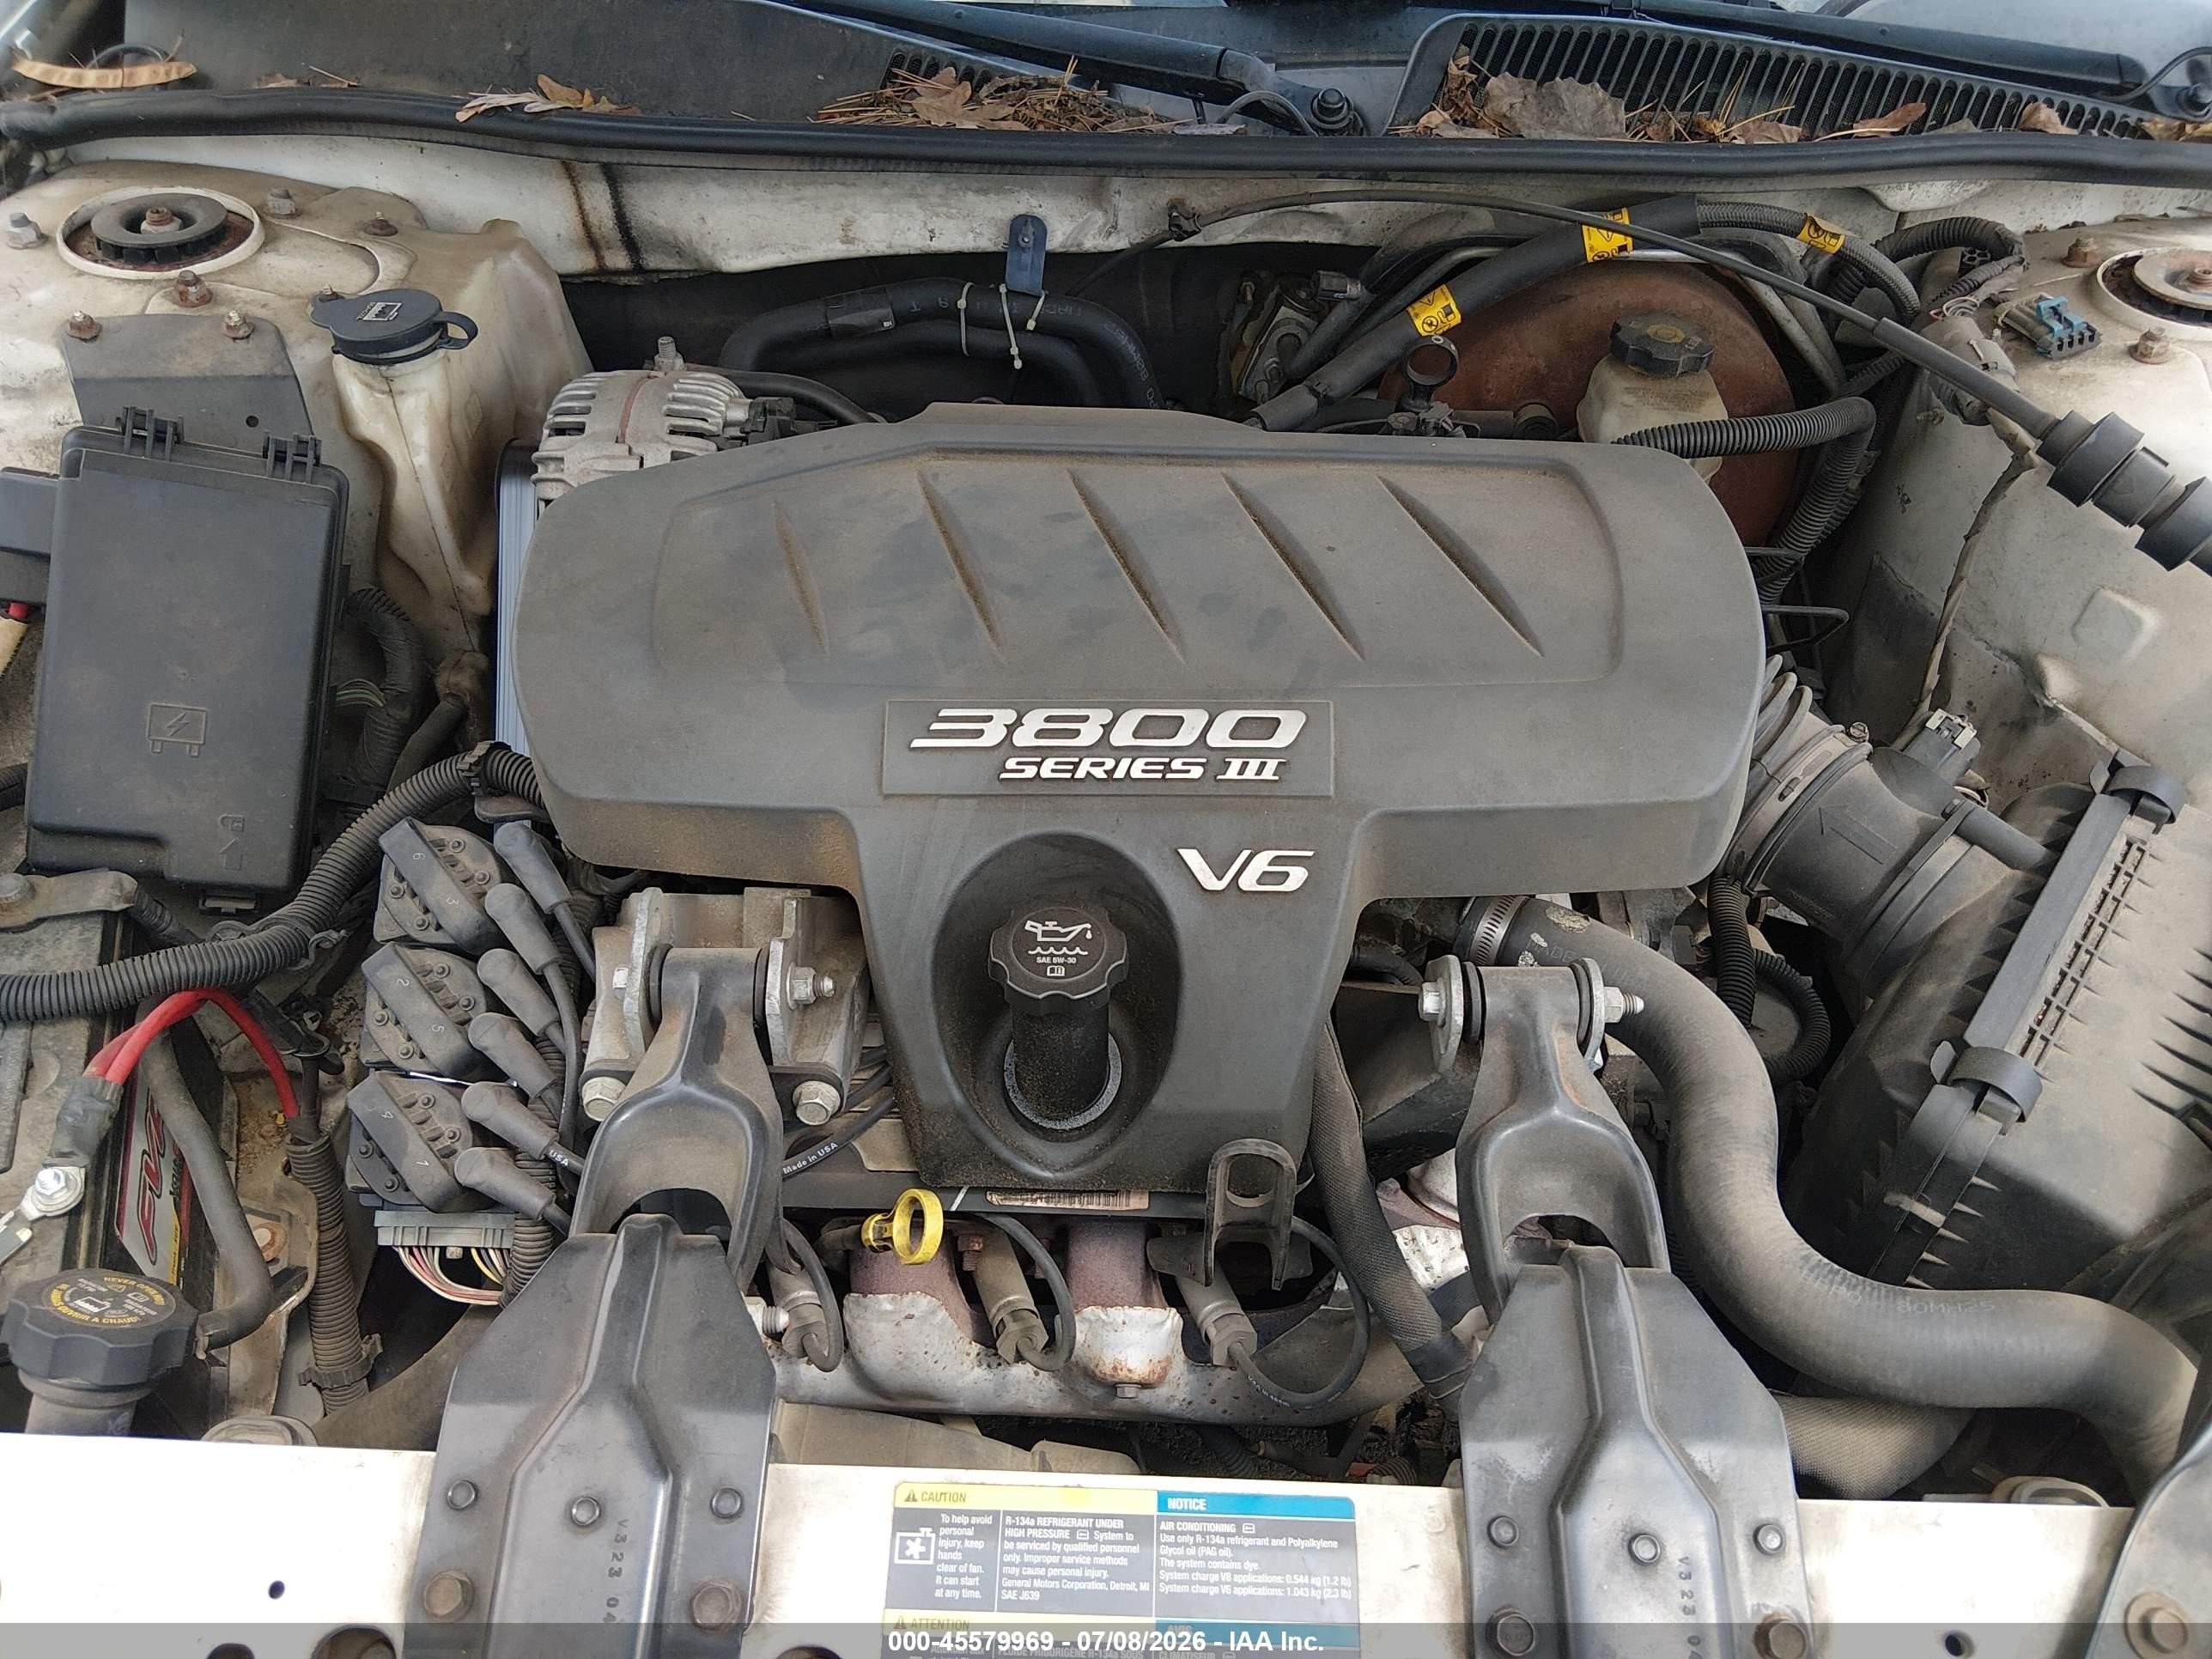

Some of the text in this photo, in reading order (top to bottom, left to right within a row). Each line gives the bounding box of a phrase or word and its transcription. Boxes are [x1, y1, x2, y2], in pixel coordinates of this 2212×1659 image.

[909, 708, 1307, 749] 3800
[999, 757, 1286, 781] SERIES III
[1176, 848, 1316, 892] V6
[550, 1150, 568, 1166] USA
[782, 1160, 808, 1175] Made
[817, 1142, 838, 1157] USA
[921, 1491, 967, 1503] CAUTION
[1168, 1498, 1206, 1510] NOTICE
[941, 1514, 993, 1525] To help avoid
[1006, 1516, 1124, 1528] R-134a REFRIGERANT UNDER
[939, 1527, 974, 1536] personal
[1160, 1522, 1237, 1533] AIR CONDITIONING
[1005, 1528, 1133, 1541] HIGH PRESSURE System to
[964, 1539, 984, 1549] keep
[1004, 1540, 1139, 1553] be serviced by qualified personnel
[1160, 1534, 1338, 1549] Use only R-134a refrigerant and Polyalkylene
[938, 1551, 963, 1560] hands
[1159, 1546, 1233, 1558] Glycol oil (PAG oil).
[1003, 1553, 1128, 1565] only. Improper service methods
[1159, 1558, 1261, 1571] The system contains dye.
[936, 1564, 984, 1573] clear of fan.
[1003, 1566, 1109, 1578] may cause personal injury.
[936, 1575, 942, 1584] It
[961, 1577, 979, 1585] start
[1002, 1577, 1031, 1588] General
[1034, 1578, 1060, 1589] Motors
[1139, 1582, 1149, 1591] MI
[1159, 1571, 1189, 1582] System
[1192, 1571, 1218, 1583] charge
[1233, 1573, 1285, 1585] applications:
[1286, 1575, 1309, 1584] 0.544
[1311, 1577, 1321, 1587] kg
[1323, 1577, 1339, 1586] (1.2
[1341, 1577, 1352, 1587] lb)
[935, 1589, 981, 1599] at any time.
[1001, 1590, 1040, 1601] SAE J639
[1159, 1583, 1189, 1594] System
[1192, 1584, 1218, 1595] charge
[1233, 1586, 1285, 1597] applications:
[1286, 1587, 1309, 1597] 1.043
[1311, 1589, 1321, 1599] kg
[1341, 1589, 1352, 1600] lb)
[911, 1618, 969, 1631] ATTENTION
